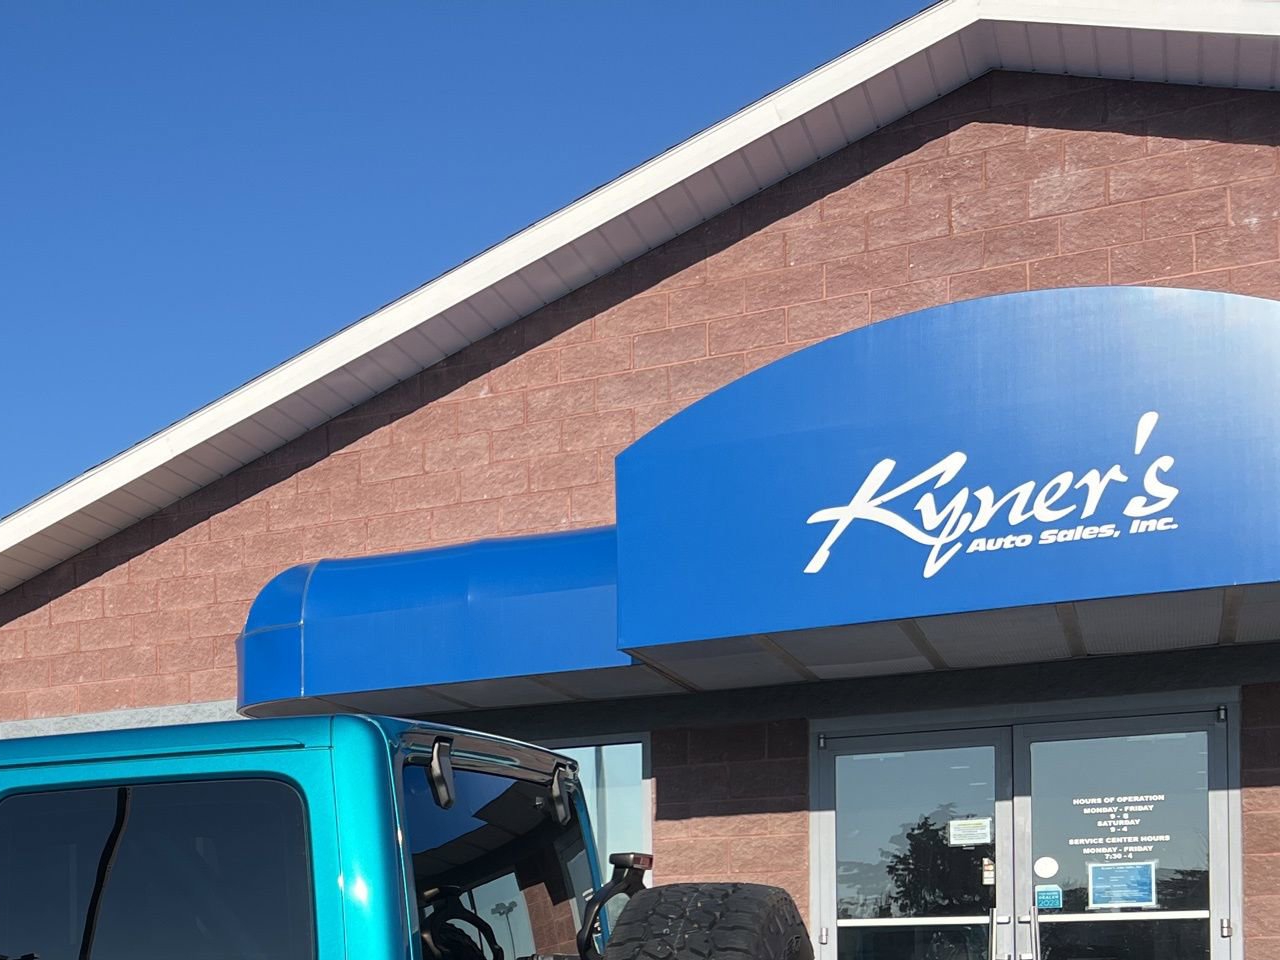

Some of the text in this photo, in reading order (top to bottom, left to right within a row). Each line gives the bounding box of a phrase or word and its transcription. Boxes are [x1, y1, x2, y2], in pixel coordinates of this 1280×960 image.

[803, 411, 1179, 578] Kyner's
[966, 516, 1179, 554] Auto Sales, Inc.
[1073, 794, 1165, 805] HOURS OF OPERATION
[1083, 806, 1118, 814] MONDAY
[1097, 819, 1141, 827] SATURDAY
[1069, 837, 1103, 846] SERVICE
[1105, 836, 1139, 844] CENTER
[1123, 845, 1153, 853] FRIDAY
